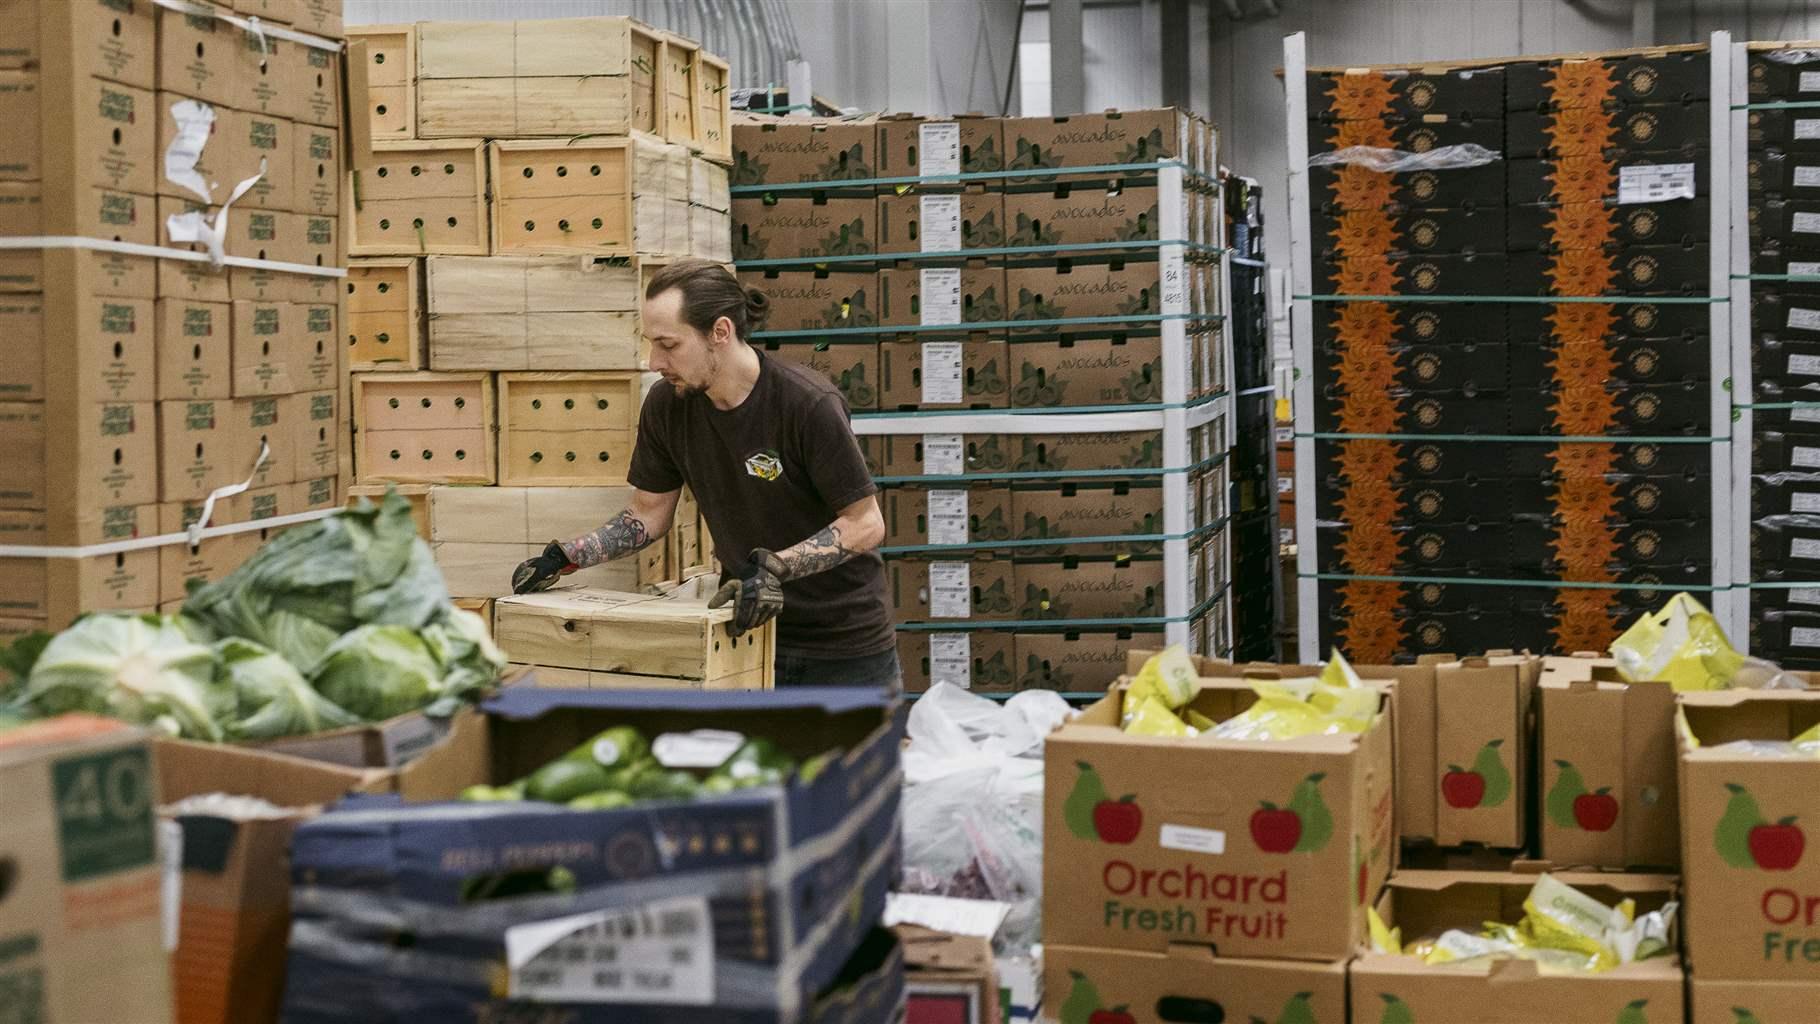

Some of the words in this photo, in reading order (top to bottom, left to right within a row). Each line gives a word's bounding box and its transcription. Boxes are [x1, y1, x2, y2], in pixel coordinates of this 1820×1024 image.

[1051, 123, 1126, 144] avocados
[759, 135, 829, 154] avocados
[759, 210, 831, 229] avocados
[1051, 198, 1126, 221] avocados
[1053, 274, 1129, 296] avocados
[1056, 350, 1131, 370] avocados
[1058, 501, 1134, 521] avocados
[1060, 573, 1134, 593] avocados
[1062, 645, 1127, 664] avocado
[61, 757, 150, 822] 40
[1103, 860, 1288, 904] Orchard
[1104, 901, 1196, 935] Fresh
[1206, 907, 1289, 939] Fruit
